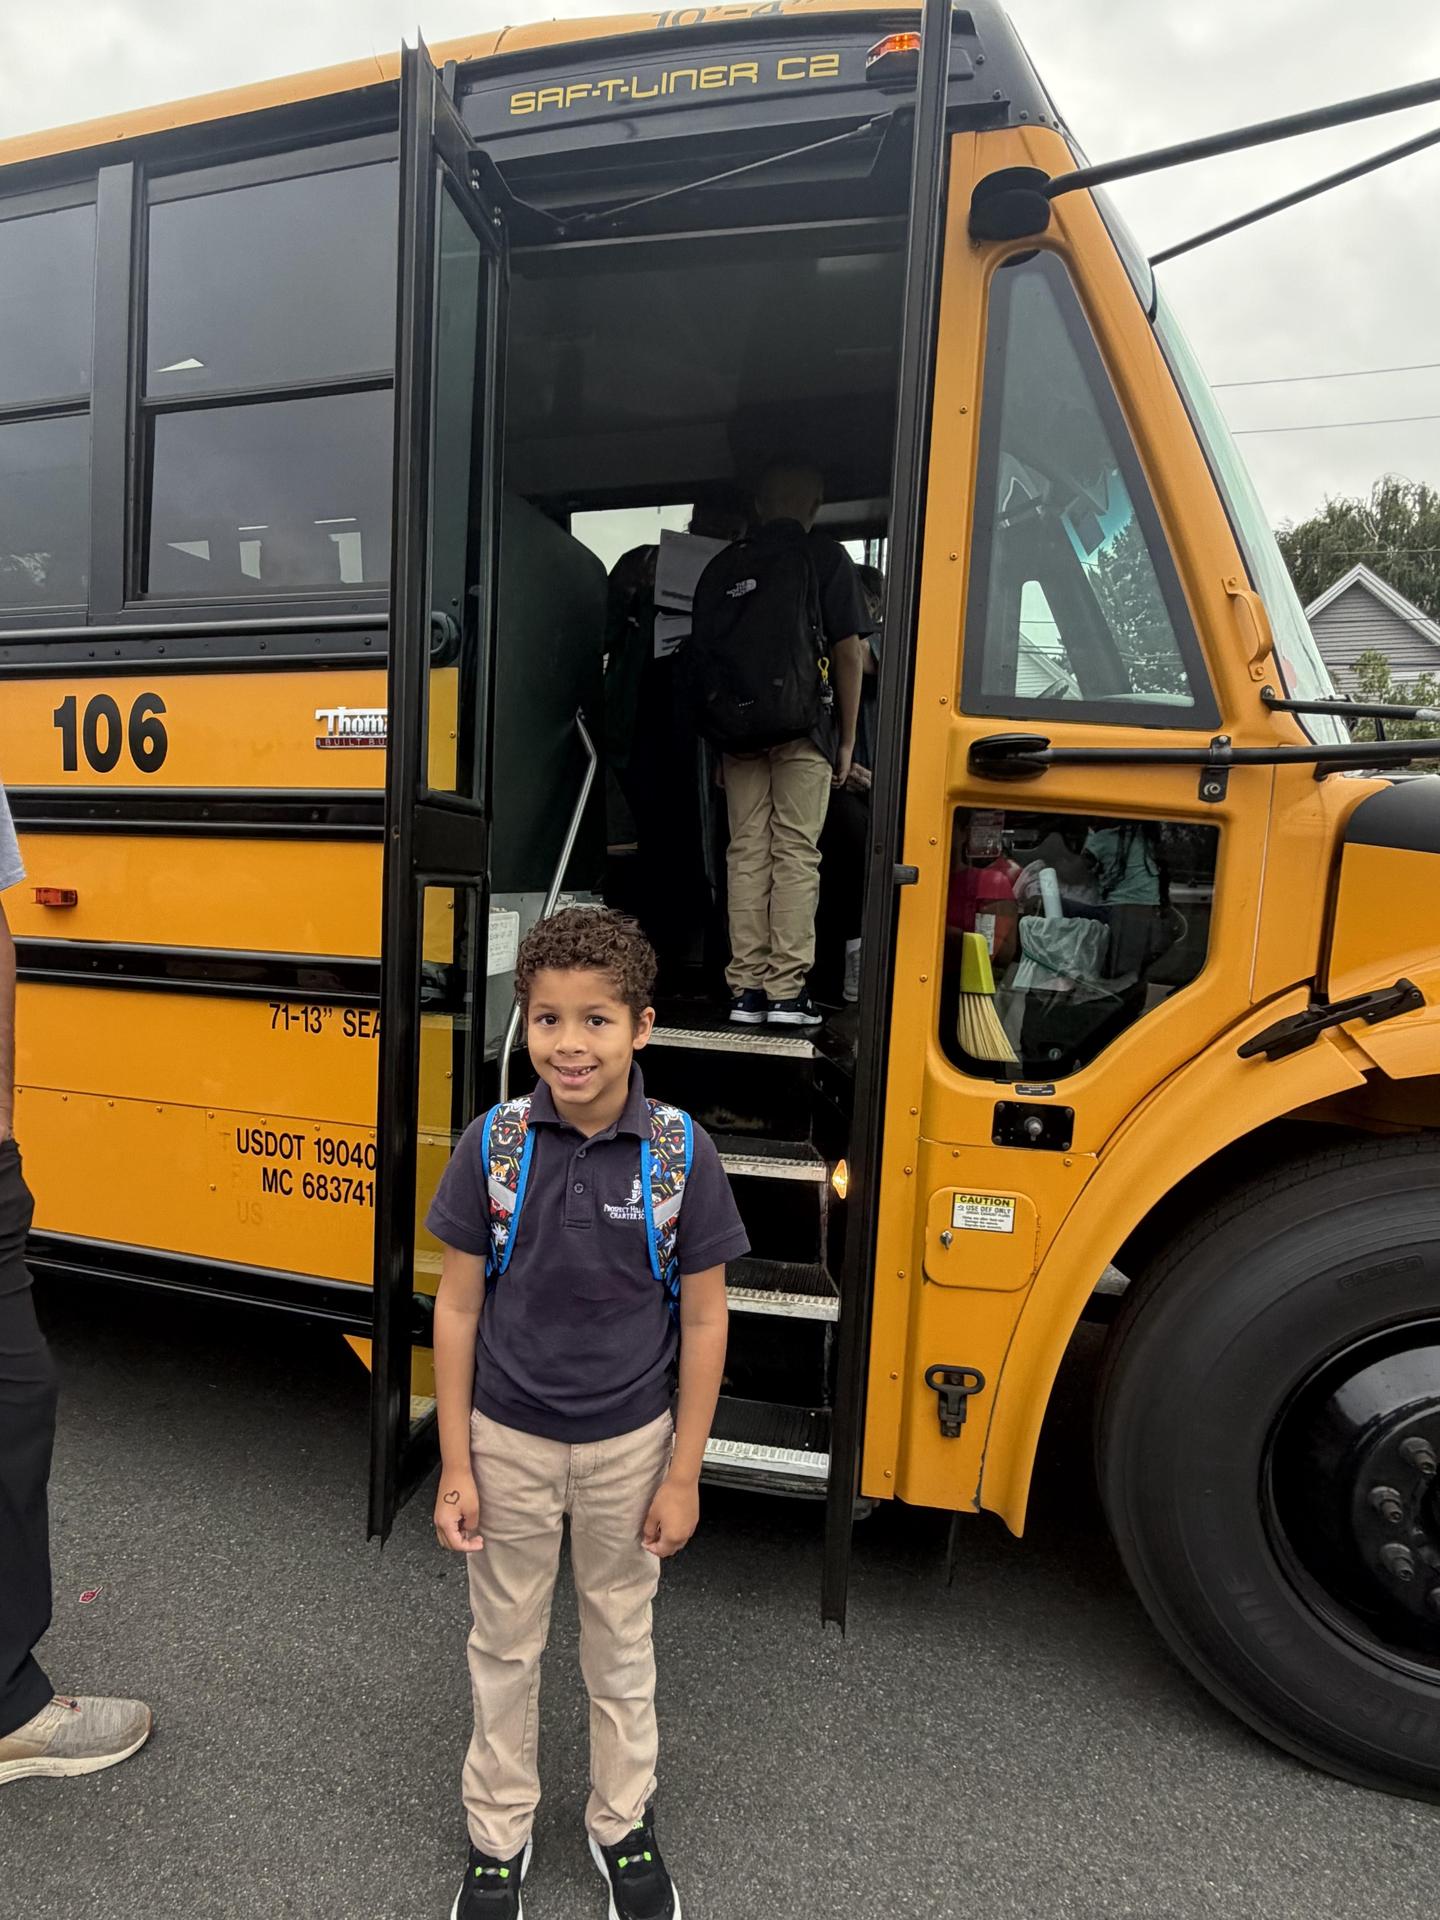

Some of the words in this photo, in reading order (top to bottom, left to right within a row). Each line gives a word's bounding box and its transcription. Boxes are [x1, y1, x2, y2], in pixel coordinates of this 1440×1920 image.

[510, 62, 758, 115] SAF-T-LINER
[777, 54, 840, 81] C2
[53, 692, 168, 774] 106
[315, 706, 387, 736] Thom
[325, 738, 362, 746] BUILT
[236, 1127, 305, 1161] USDOT
[313, 1137, 377, 1171] 19040
[262, 1166, 293, 1196] MC
[302, 1172, 374, 1208] 683741
[960, 1195, 1010, 1206] CAUTION
